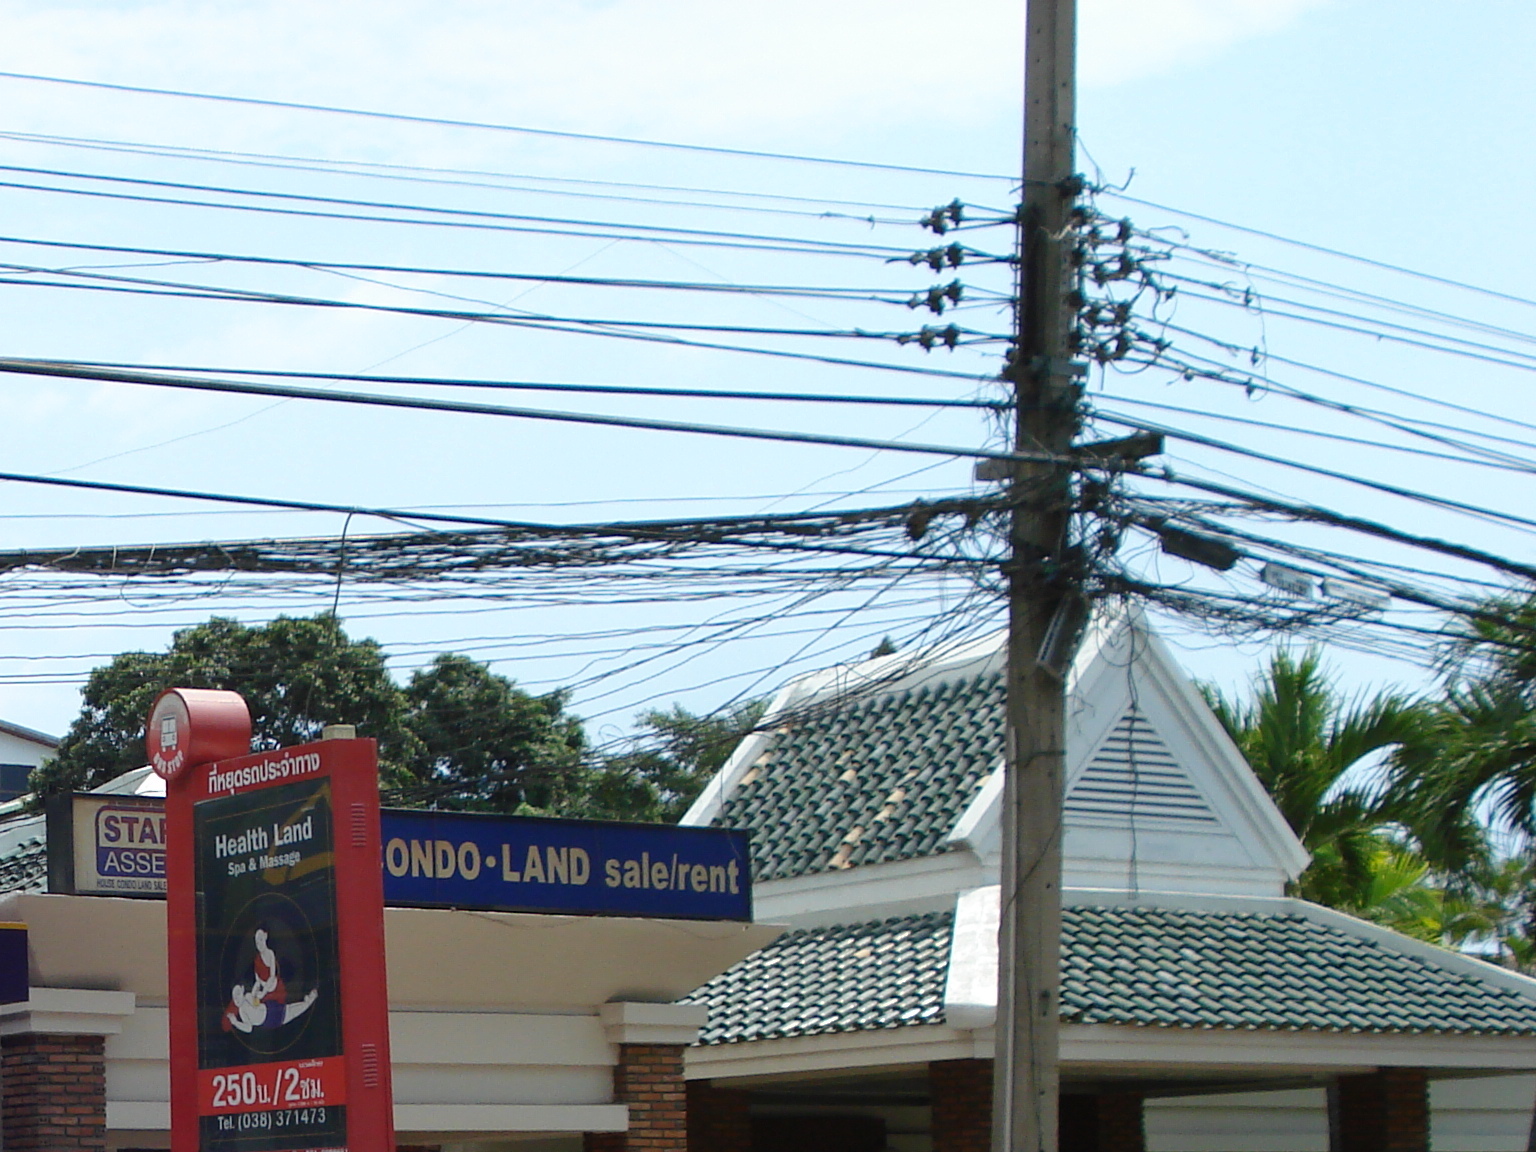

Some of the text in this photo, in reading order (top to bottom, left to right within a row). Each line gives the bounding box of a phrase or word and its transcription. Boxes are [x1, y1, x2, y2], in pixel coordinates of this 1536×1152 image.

[216, 815, 312, 859] Health Land
[227, 851, 301, 877] Spa & Massage
[605, 852, 739, 894] sale/rent
[217, 1107, 326, 1131] Tel. (038) 371473
